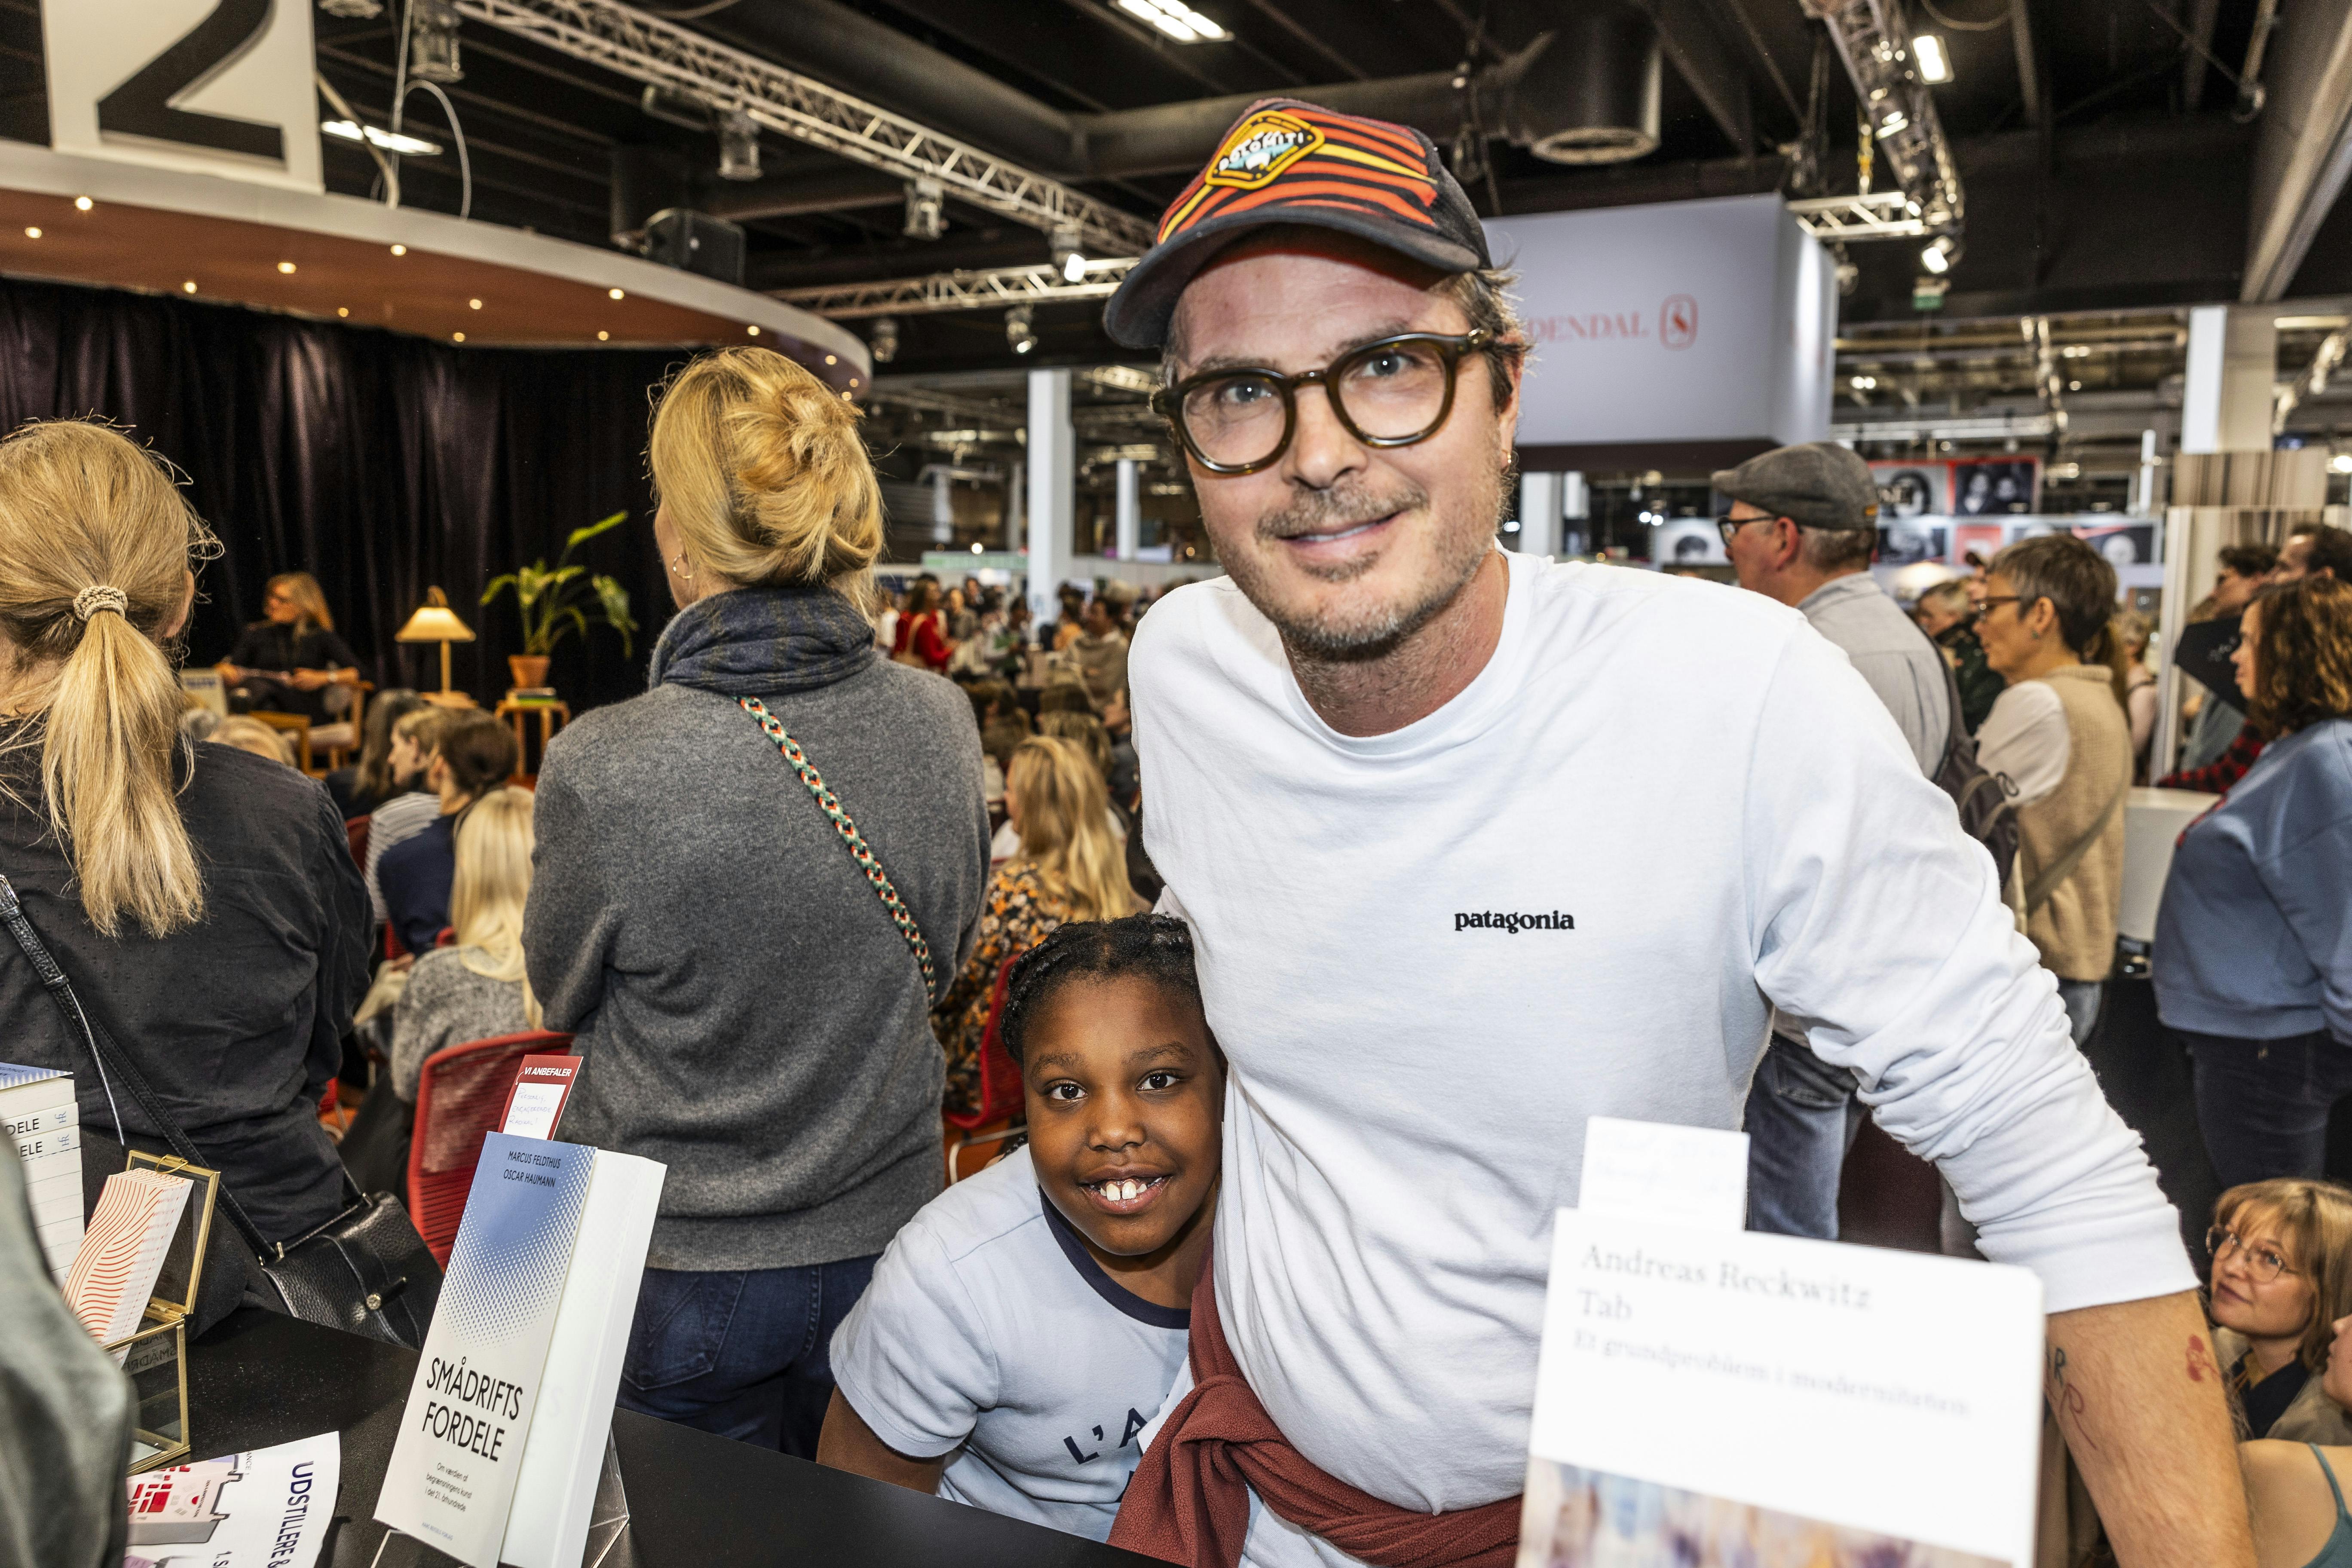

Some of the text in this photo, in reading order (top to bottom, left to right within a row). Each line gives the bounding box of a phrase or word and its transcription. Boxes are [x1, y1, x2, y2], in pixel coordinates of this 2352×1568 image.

[97, 0, 285, 161] 2
[1455, 910, 1575, 934] patagonia
[531, 1067, 572, 1077] ANBEFALER
[508, 1151, 561, 1169] MARCUS FELDTHUS
[504, 1169, 556, 1188] OSCAR HAUMANN
[1579, 1242, 1873, 1311] Andreas Reckwitz
[1577, 1287, 1633, 1323] Tab
[427, 1356, 523, 1420] SMÅDRIFTS
[422, 1401, 505, 1461] FORDELE
[267, 1461, 314, 1568] UDSTILLERE &
[213, 1560, 230, 1568] S
